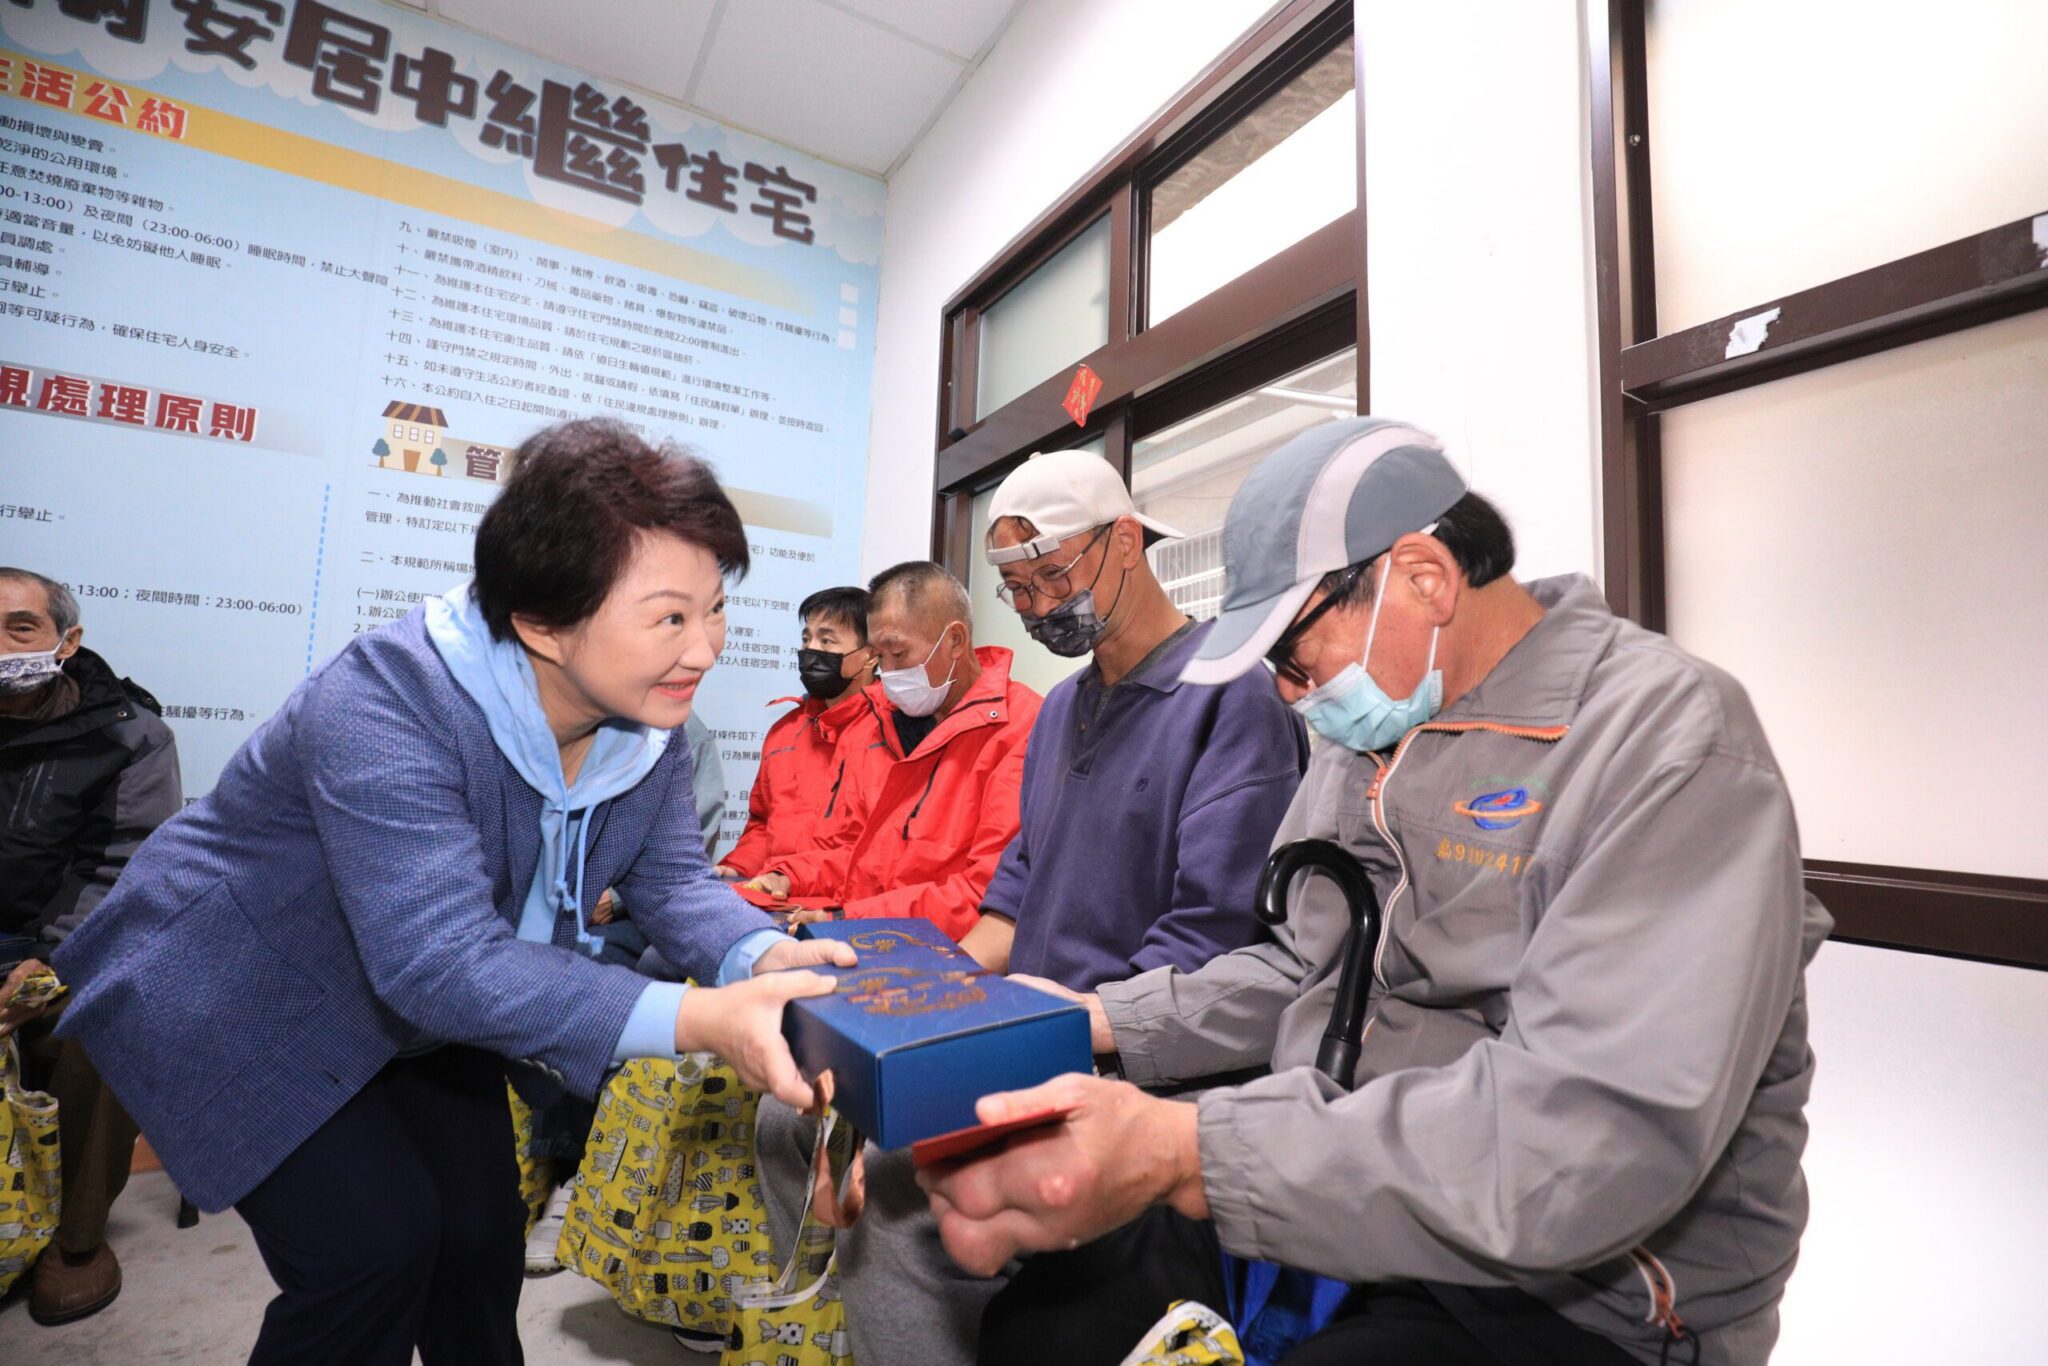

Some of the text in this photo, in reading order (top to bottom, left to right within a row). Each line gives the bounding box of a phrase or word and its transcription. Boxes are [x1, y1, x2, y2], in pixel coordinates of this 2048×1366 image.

[0, 0, 818, 245] 安居中繼住宅
[0, 208, 232, 270] 適當音量，以免妨礙他人睡眠。
[0, 503, 65, 523] 行舉止。
[367, 489, 487, 515] 一、為推動社會救助
[160, 704, 255, 722] 騷擾等行為。
